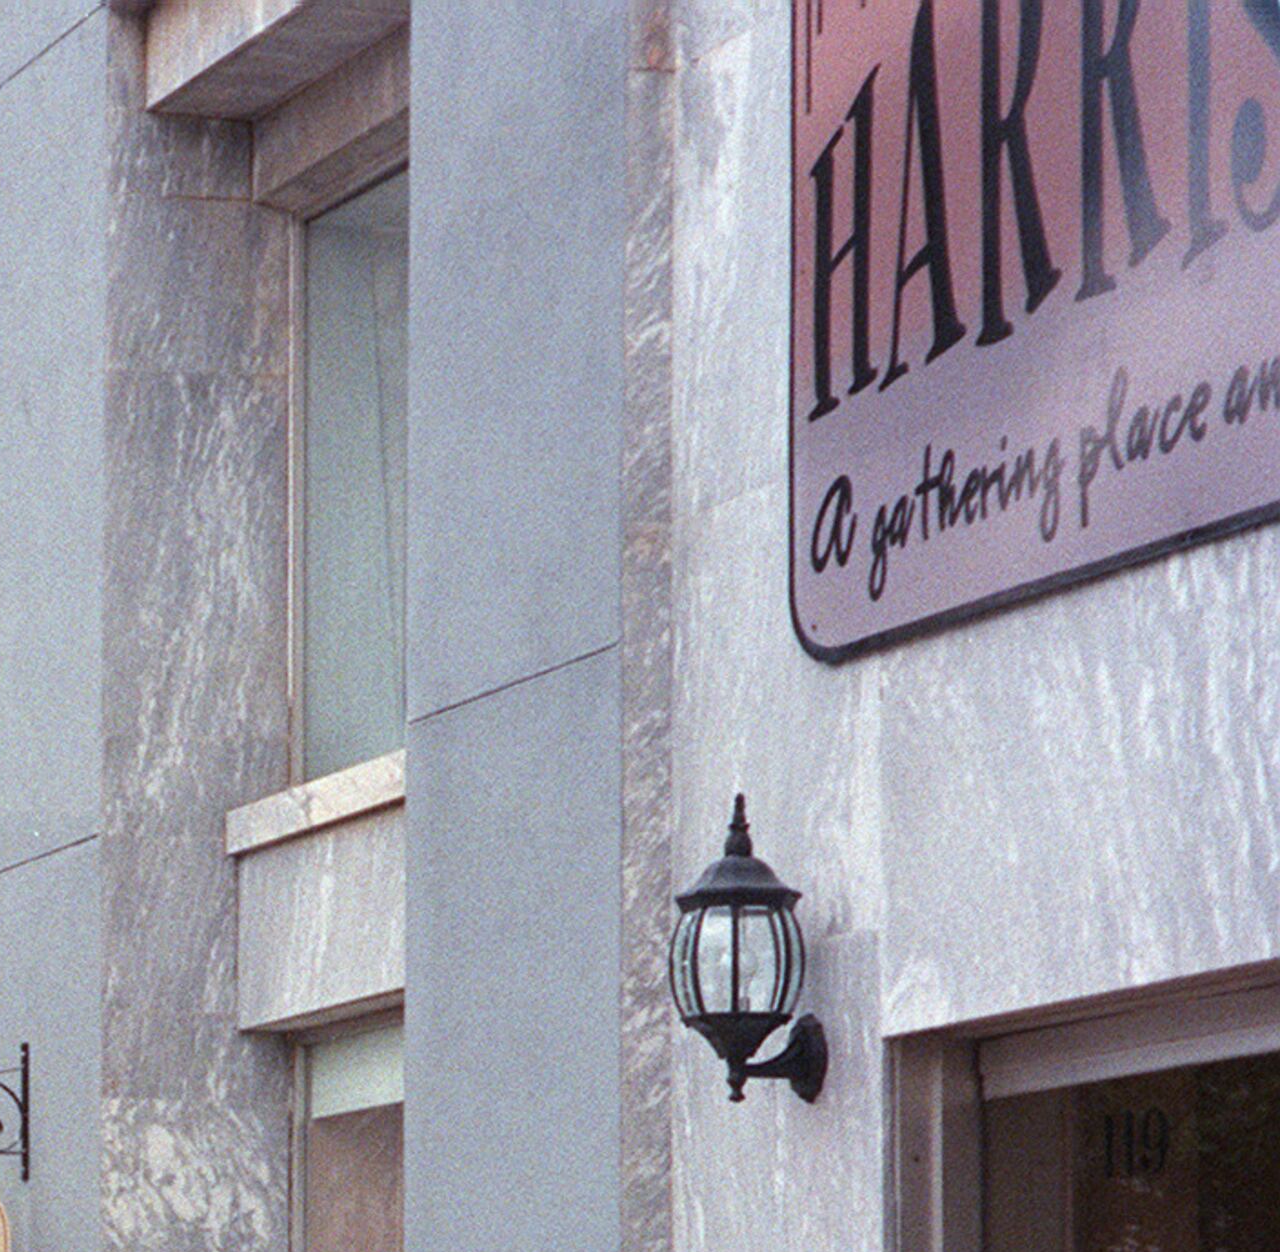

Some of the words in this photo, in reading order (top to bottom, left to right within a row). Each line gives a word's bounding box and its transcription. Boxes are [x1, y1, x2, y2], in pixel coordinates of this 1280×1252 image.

[810, 474, 858, 574] A
[868, 434, 1065, 603] gathering
[1077, 364, 1213, 529] place
